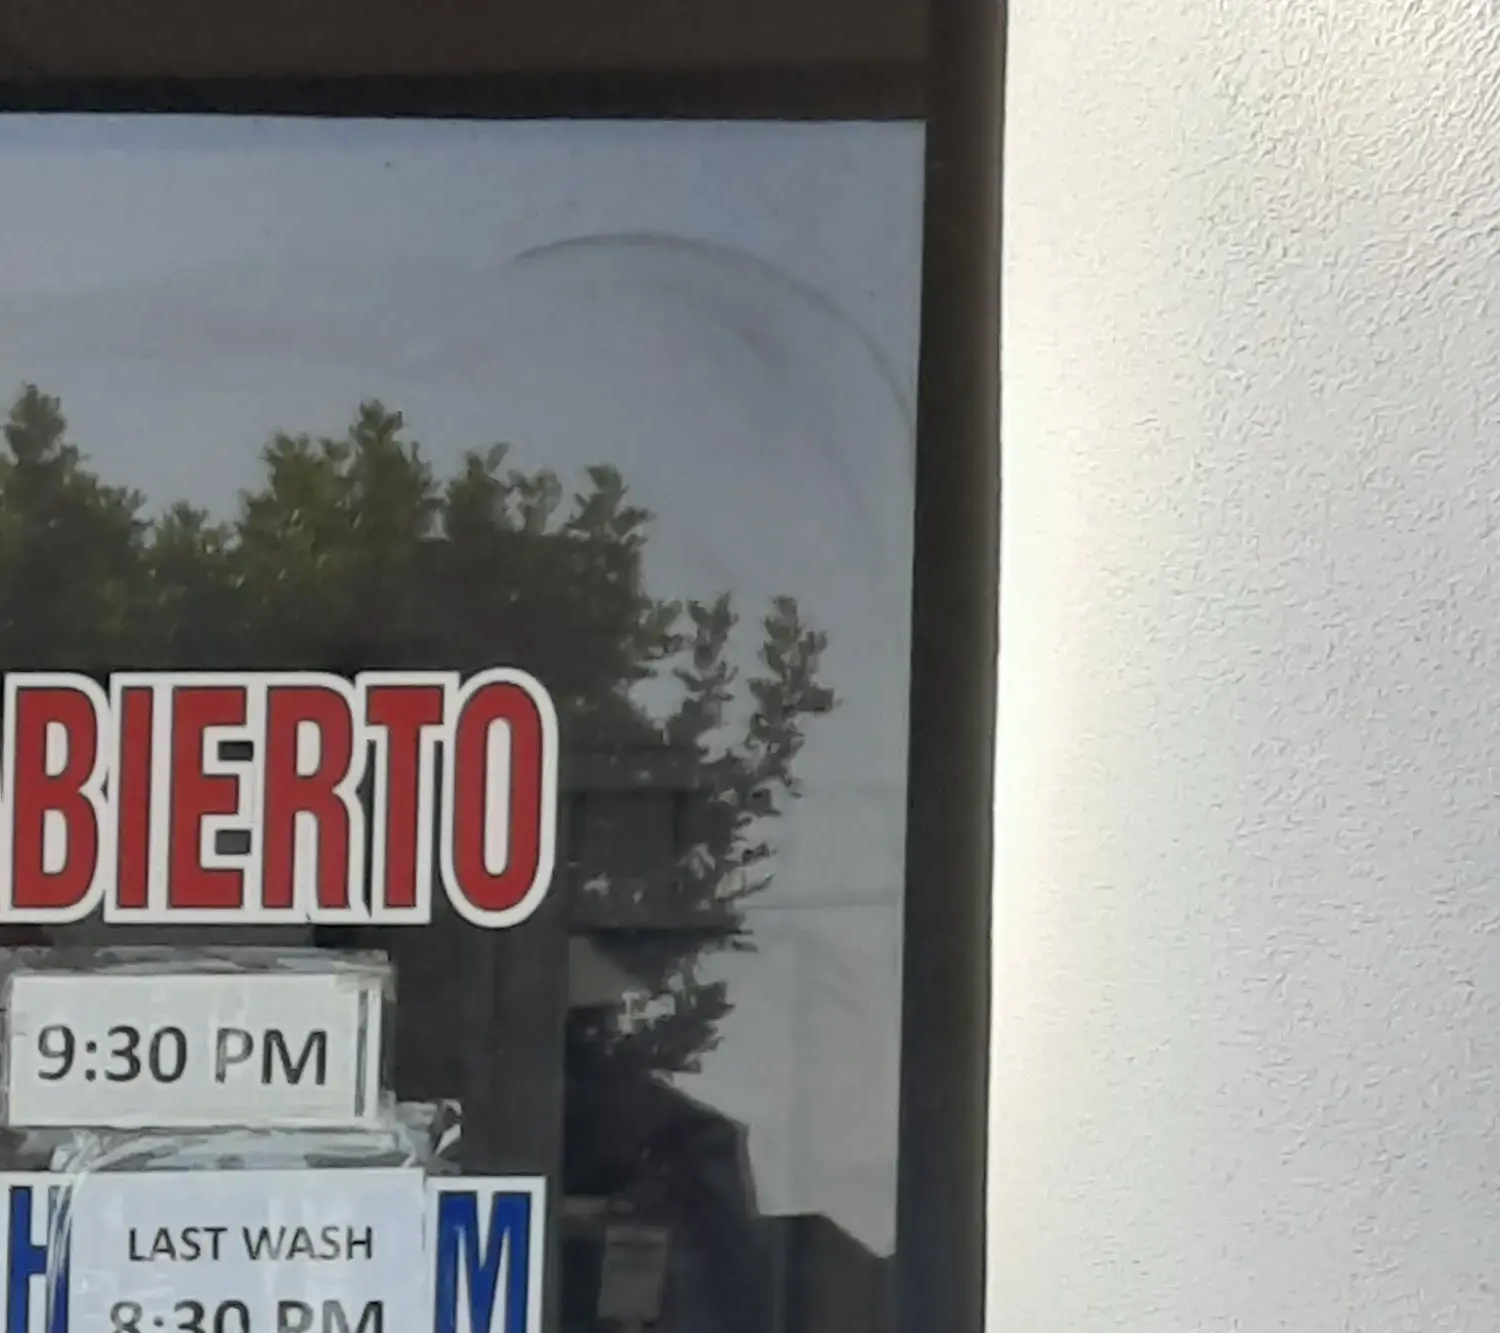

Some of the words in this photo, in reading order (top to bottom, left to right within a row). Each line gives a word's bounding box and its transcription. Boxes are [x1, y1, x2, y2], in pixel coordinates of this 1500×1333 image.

[36, 1023, 189, 1084] 9:30
[214, 1026, 329, 1086] PM
[128, 1226, 228, 1263] LAST
[242, 1225, 374, 1262] WASH
